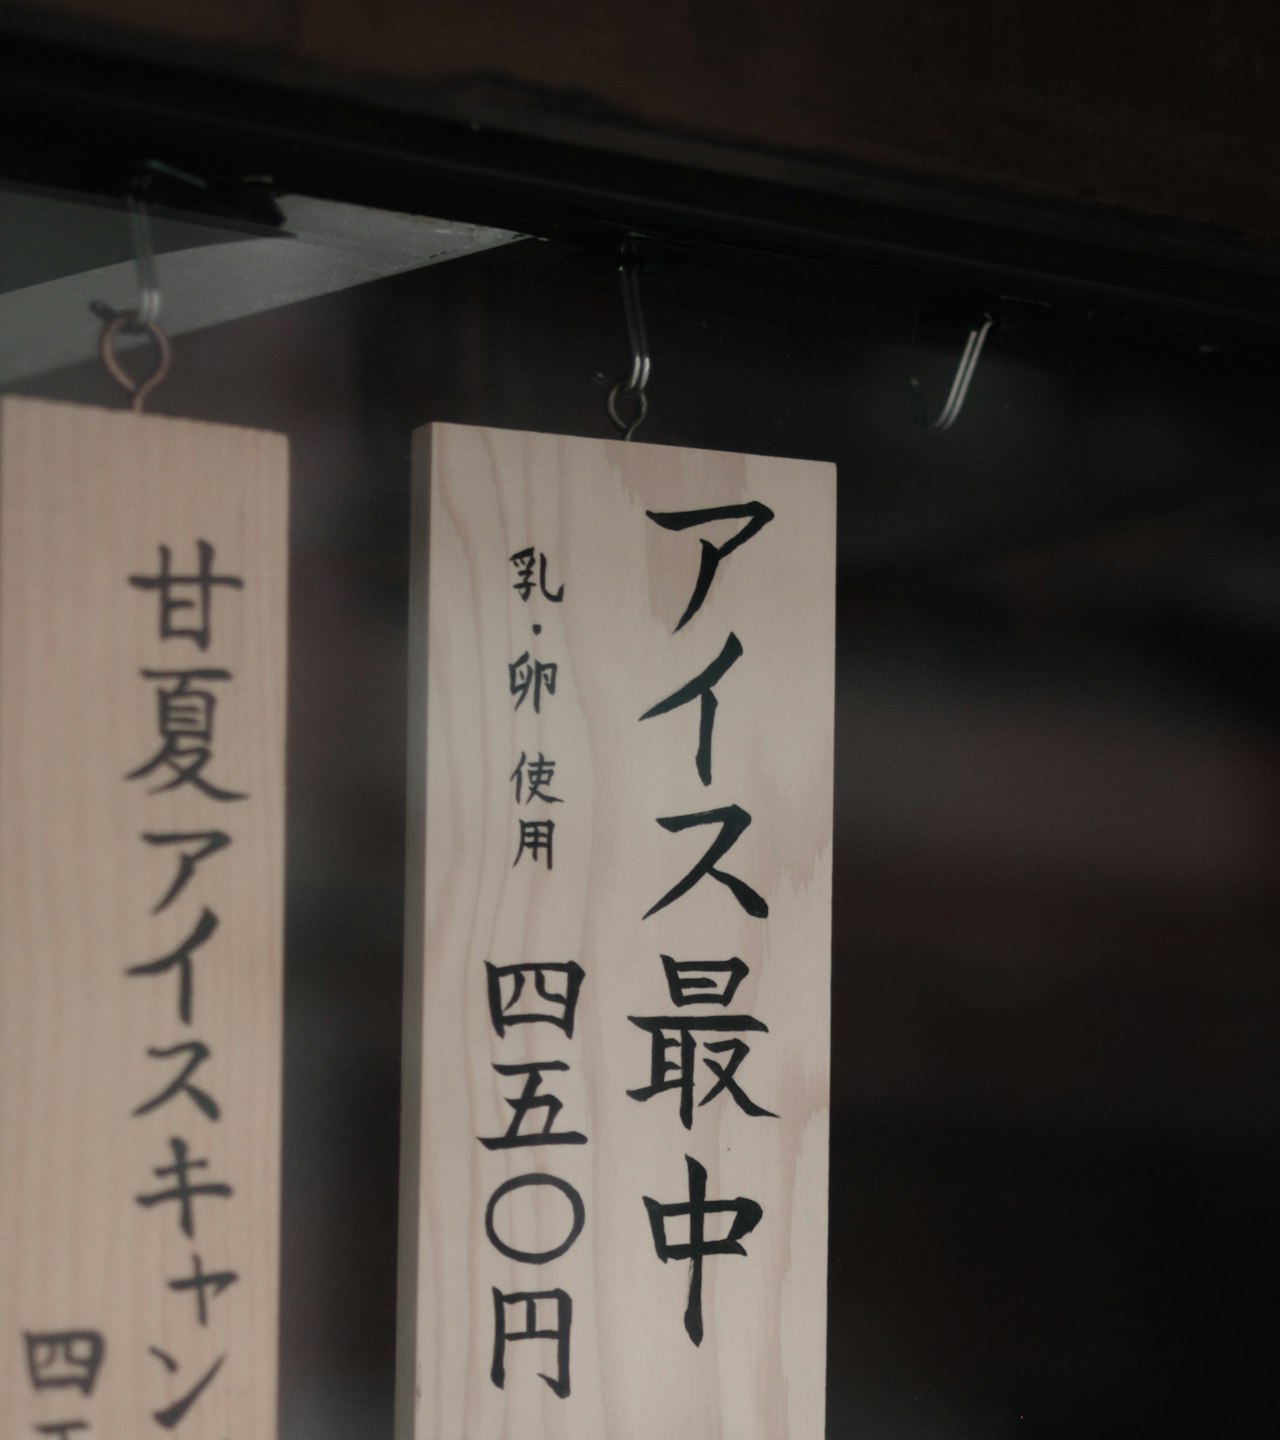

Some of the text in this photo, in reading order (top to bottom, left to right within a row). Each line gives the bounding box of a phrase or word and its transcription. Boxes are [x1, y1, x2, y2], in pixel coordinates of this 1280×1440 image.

[477, 960, 588, 1399] 四五〇円
[625, 500, 782, 1348] アイス最中
